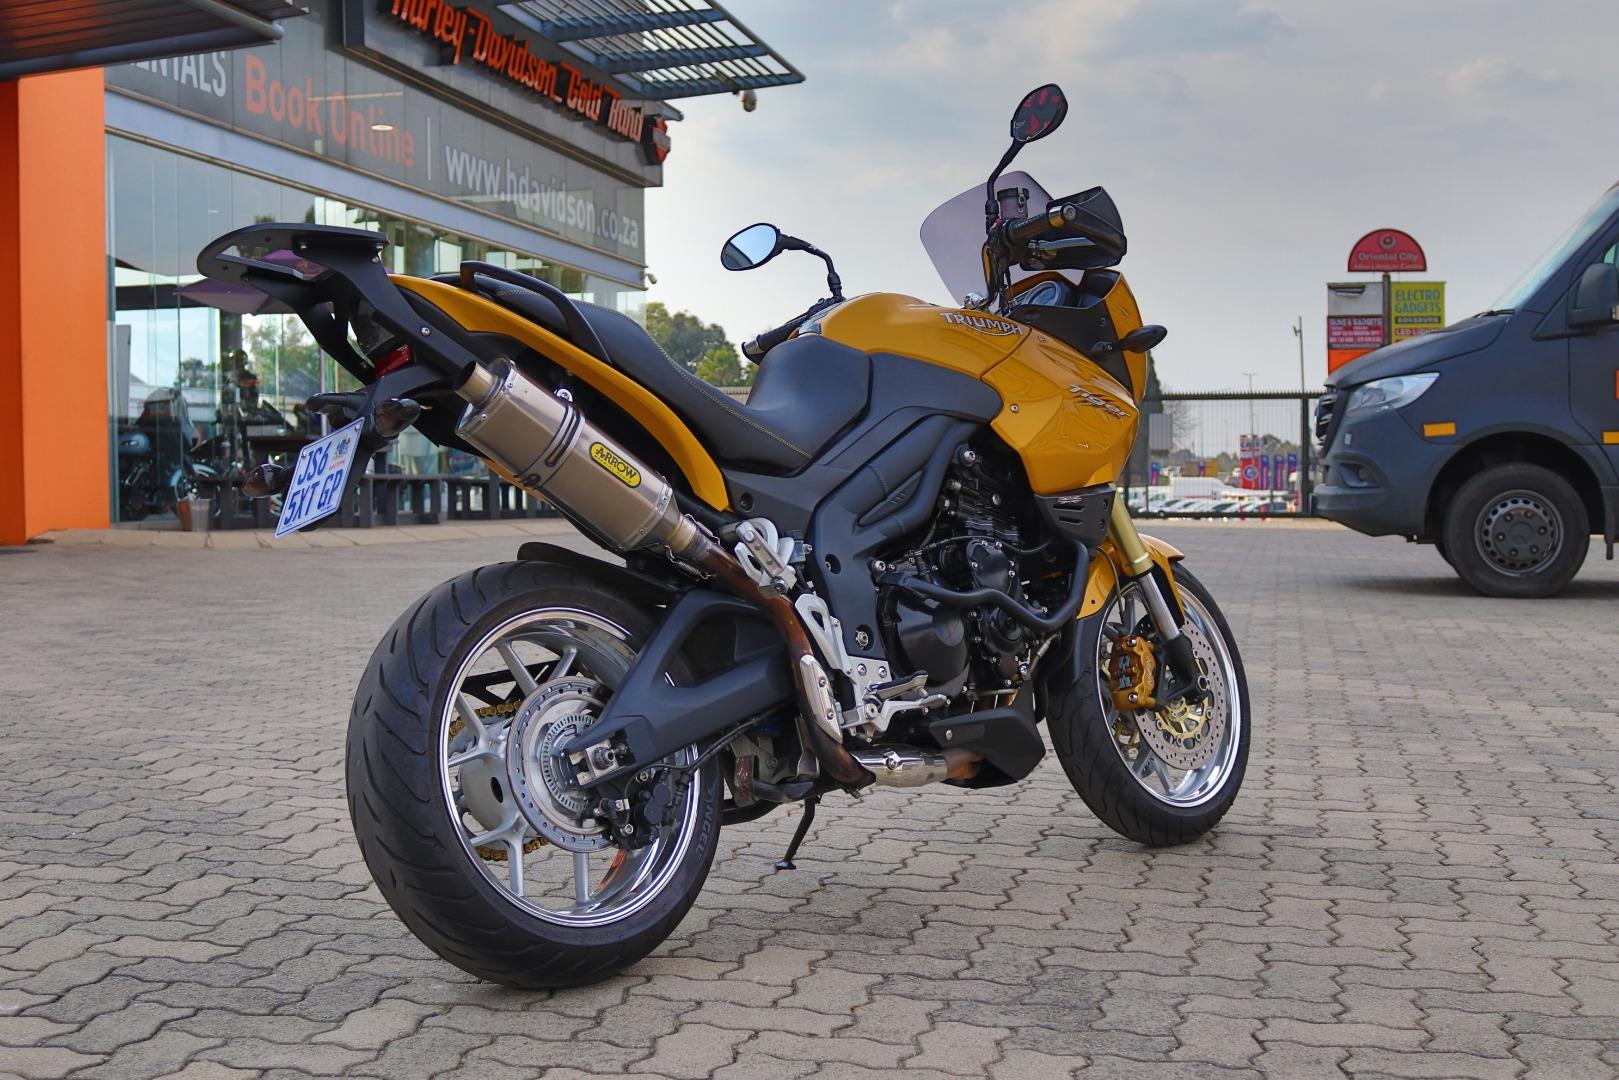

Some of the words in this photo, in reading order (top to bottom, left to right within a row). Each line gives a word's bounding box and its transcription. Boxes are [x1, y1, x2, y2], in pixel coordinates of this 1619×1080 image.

[560, 62, 604, 121] Gold
[244, 54, 323, 136] Book
[330, 90, 416, 168] Online
[444, 144, 640, 249] www.hdavidson.co.za
[1358, 252, 1397, 261] Oriental
[1398, 252, 1418, 263] City
[1395, 289, 1440, 301] ELECTRO
[1395, 302, 1441, 314] GADGETS
[940, 312, 1023, 336] TRIUMPH
[297, 441, 333, 486] JS6
[595, 447, 638, 479] ARROW
[283, 480, 321, 526] 5XT
[317, 469, 344, 510] GP
